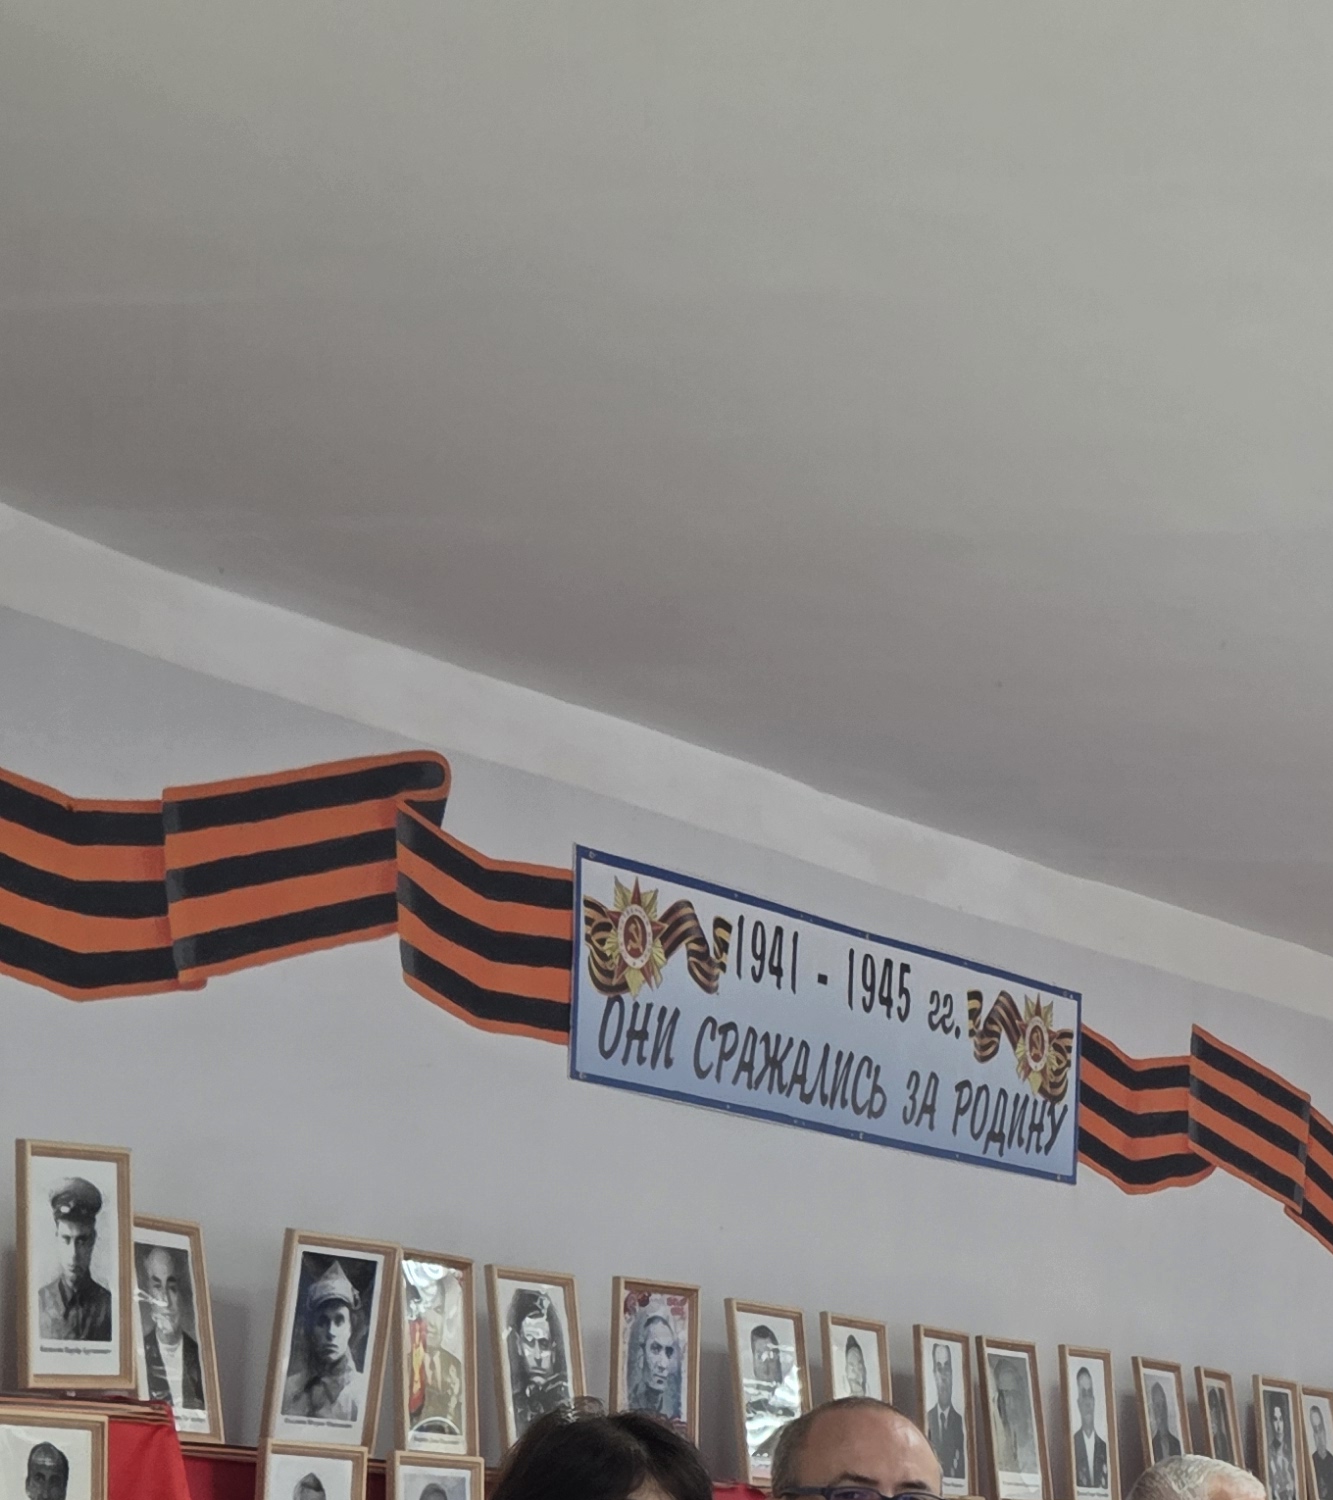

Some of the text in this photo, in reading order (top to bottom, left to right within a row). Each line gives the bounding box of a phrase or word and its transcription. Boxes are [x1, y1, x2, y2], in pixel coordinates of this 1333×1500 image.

[736, 915, 800, 995] 1941
[816, 973, 828, 985] -
[847, 948, 912, 1022] 1945
[597, 995, 1069, 1158] ОНИ СРАЖАЛИСЬ ЗА РОДИНУ
